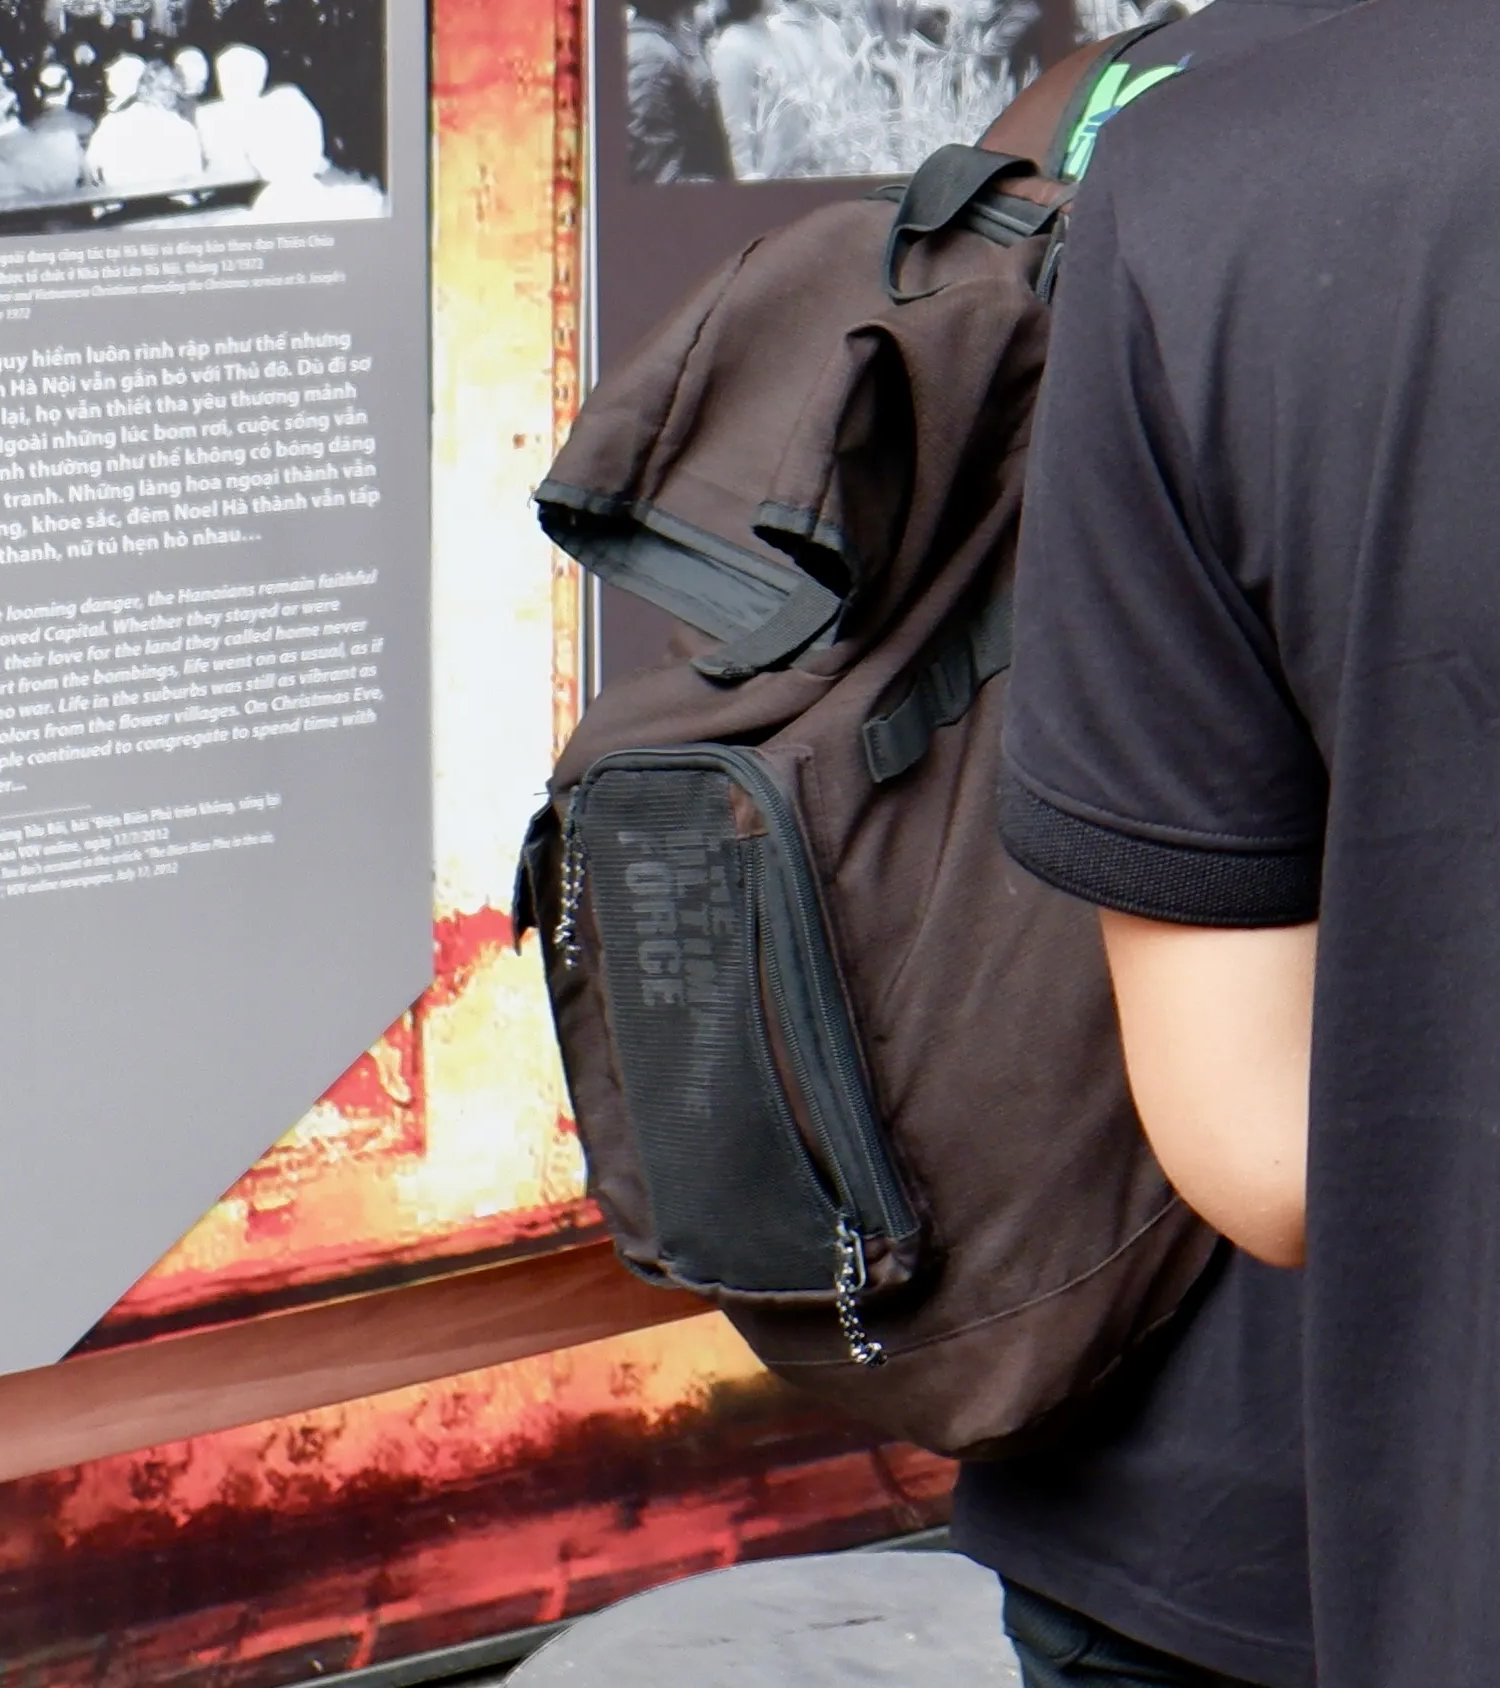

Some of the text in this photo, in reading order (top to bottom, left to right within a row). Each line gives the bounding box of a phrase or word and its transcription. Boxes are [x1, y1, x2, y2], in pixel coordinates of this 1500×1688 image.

[5, 601, 77, 621] looming
[79, 597, 143, 614] danger,
[147, 590, 175, 606] the
[177, 584, 255, 603] Hanoians
[258, 576, 315, 594] remain
[318, 568, 377, 588] faithful
